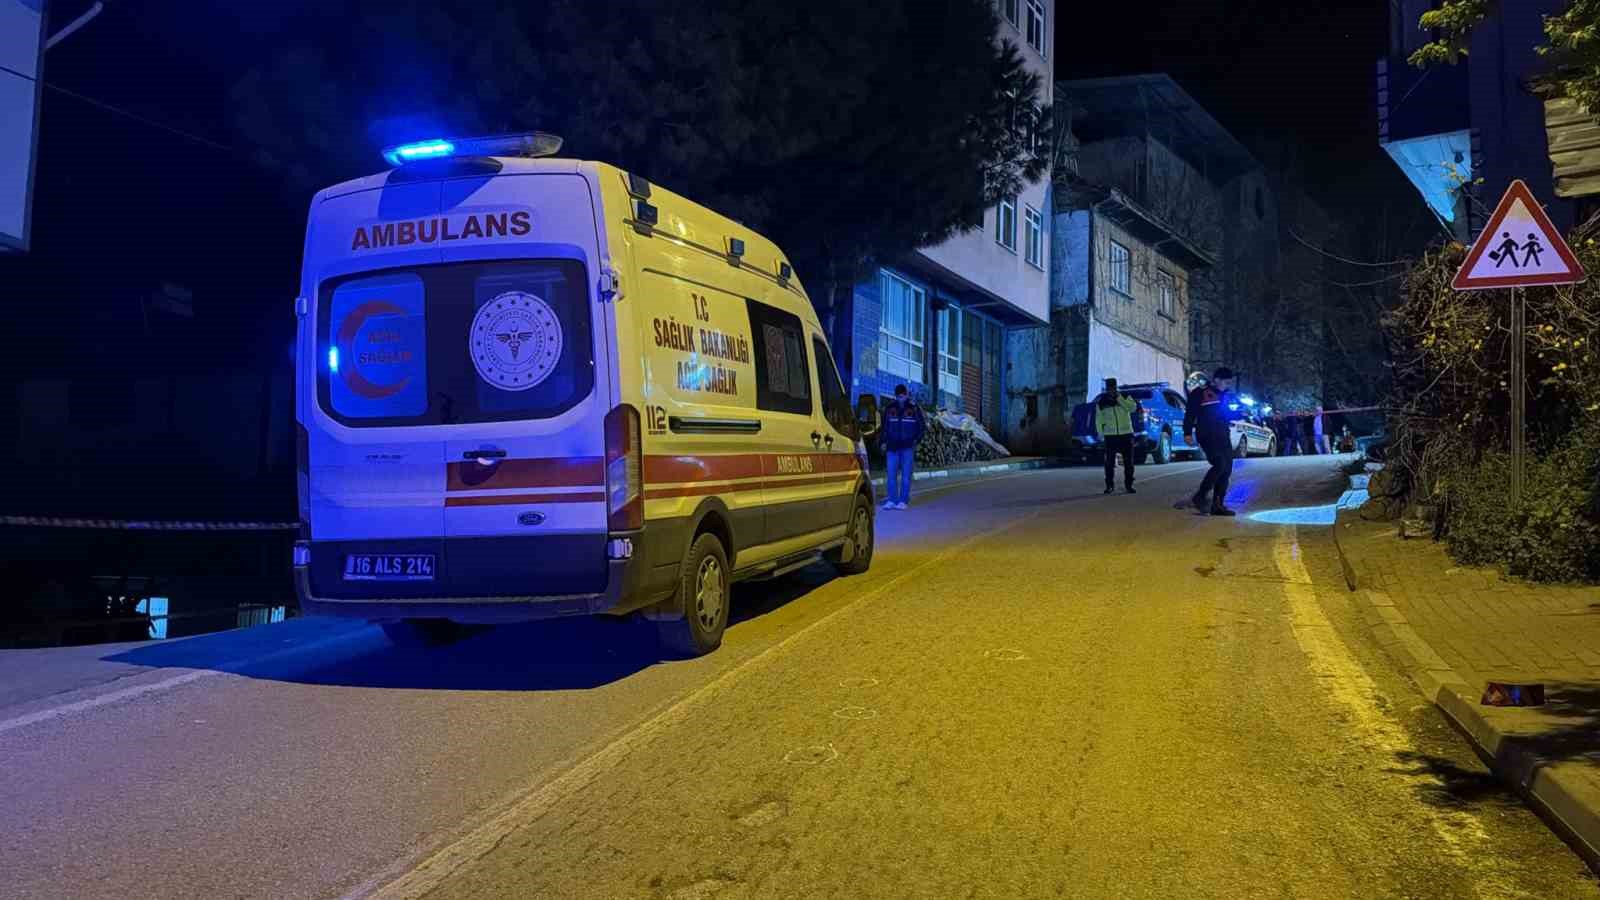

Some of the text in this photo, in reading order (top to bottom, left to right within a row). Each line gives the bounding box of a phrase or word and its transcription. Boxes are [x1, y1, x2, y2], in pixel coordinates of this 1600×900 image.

[352, 211, 531, 250] AMBULANS
[653, 316, 749, 364] SAĞLIK BAKANLIĞI
[704, 363, 737, 395] SAĞLIK
[646, 405, 667, 430] 112
[776, 455, 814, 473] AMBULANS
[356, 557, 431, 575] 16 ALS 214
